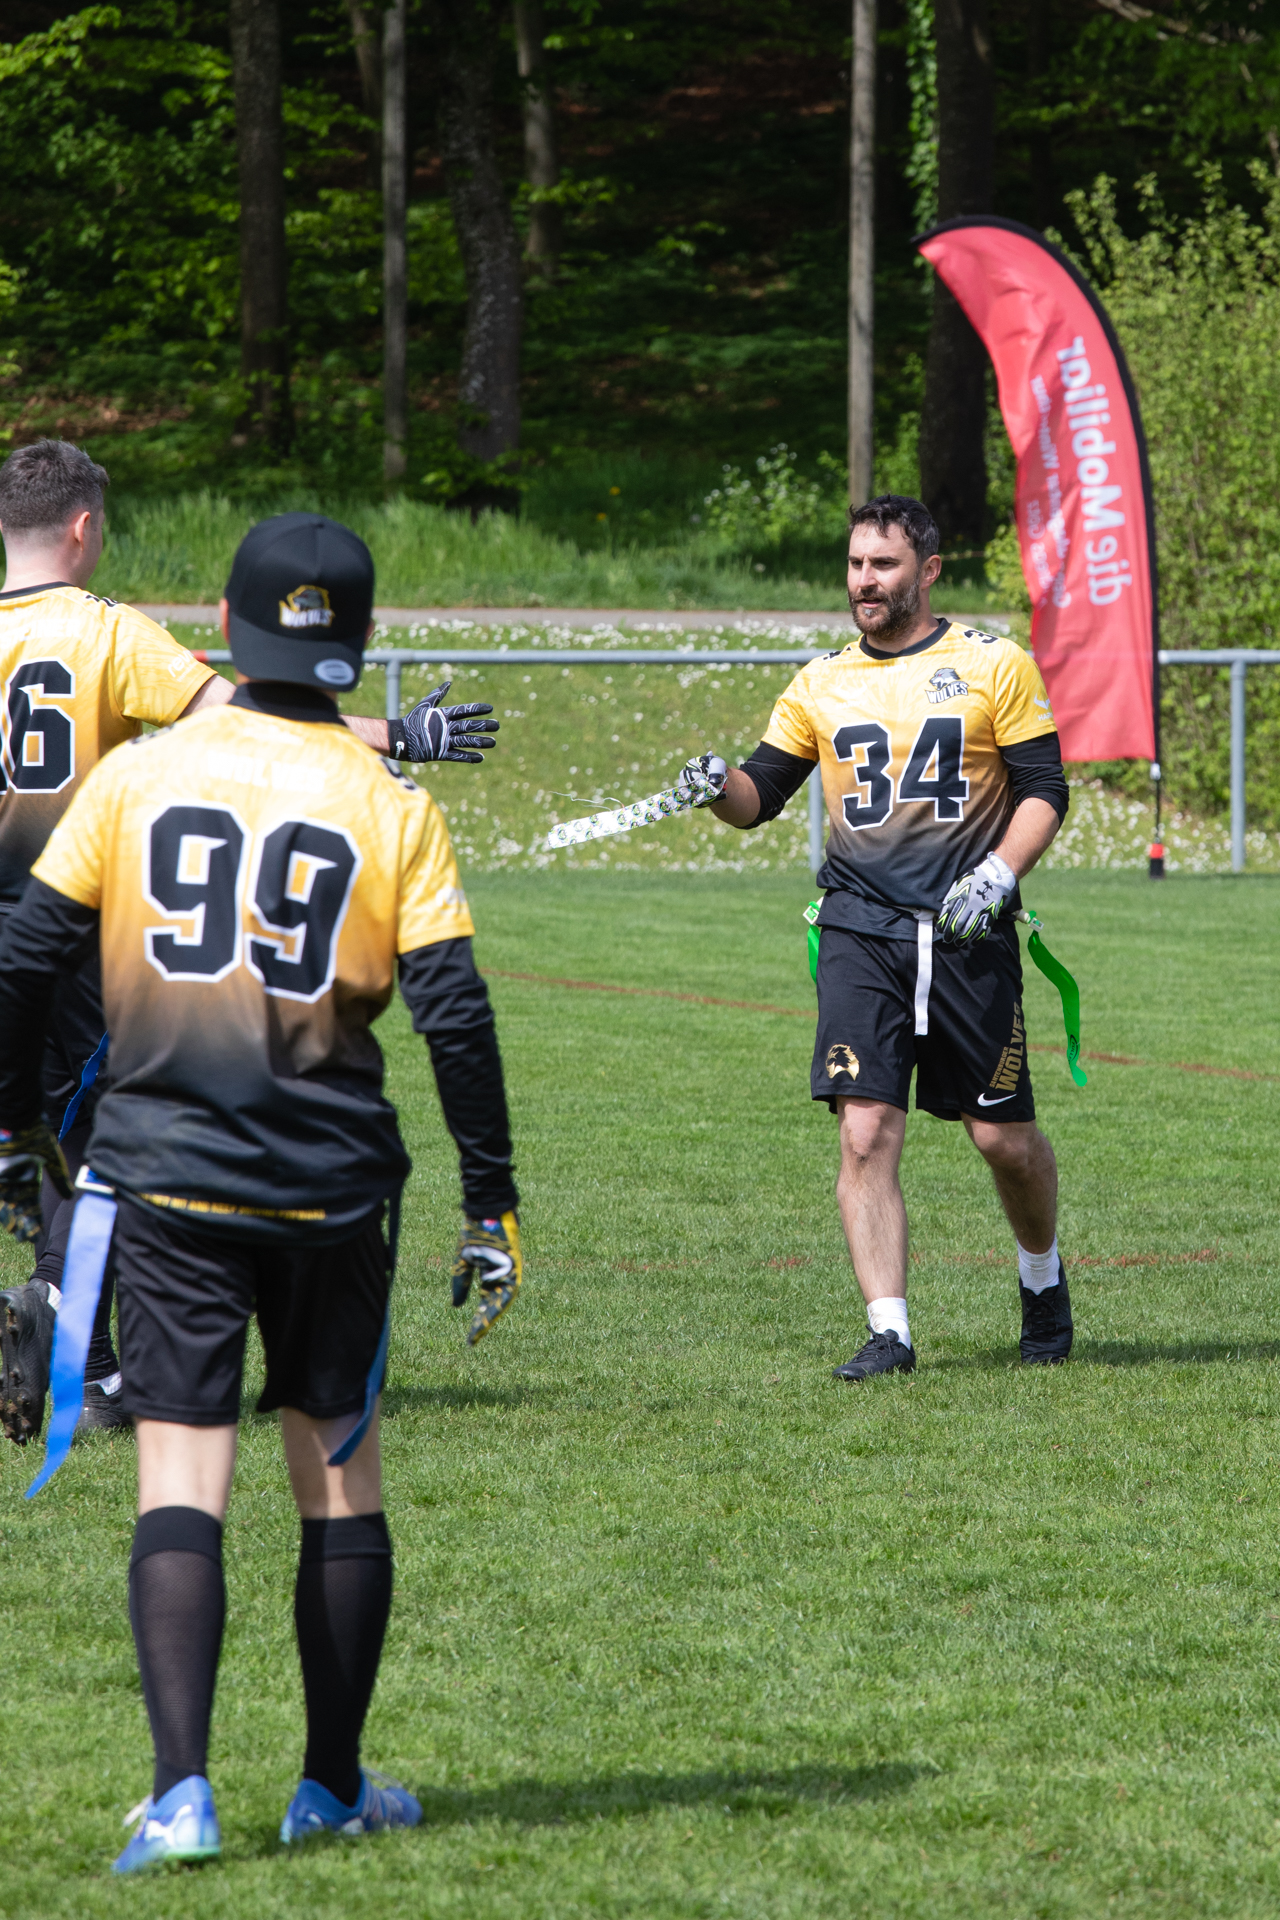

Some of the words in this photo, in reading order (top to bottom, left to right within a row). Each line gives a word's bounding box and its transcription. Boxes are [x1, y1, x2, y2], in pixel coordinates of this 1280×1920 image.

[0, 656, 76, 794] 6
[926, 682, 970, 704] WOLVES
[207, 749, 327, 794] WOLVES
[831, 714, 970, 831] 34
[142, 800, 363, 1004] 99
